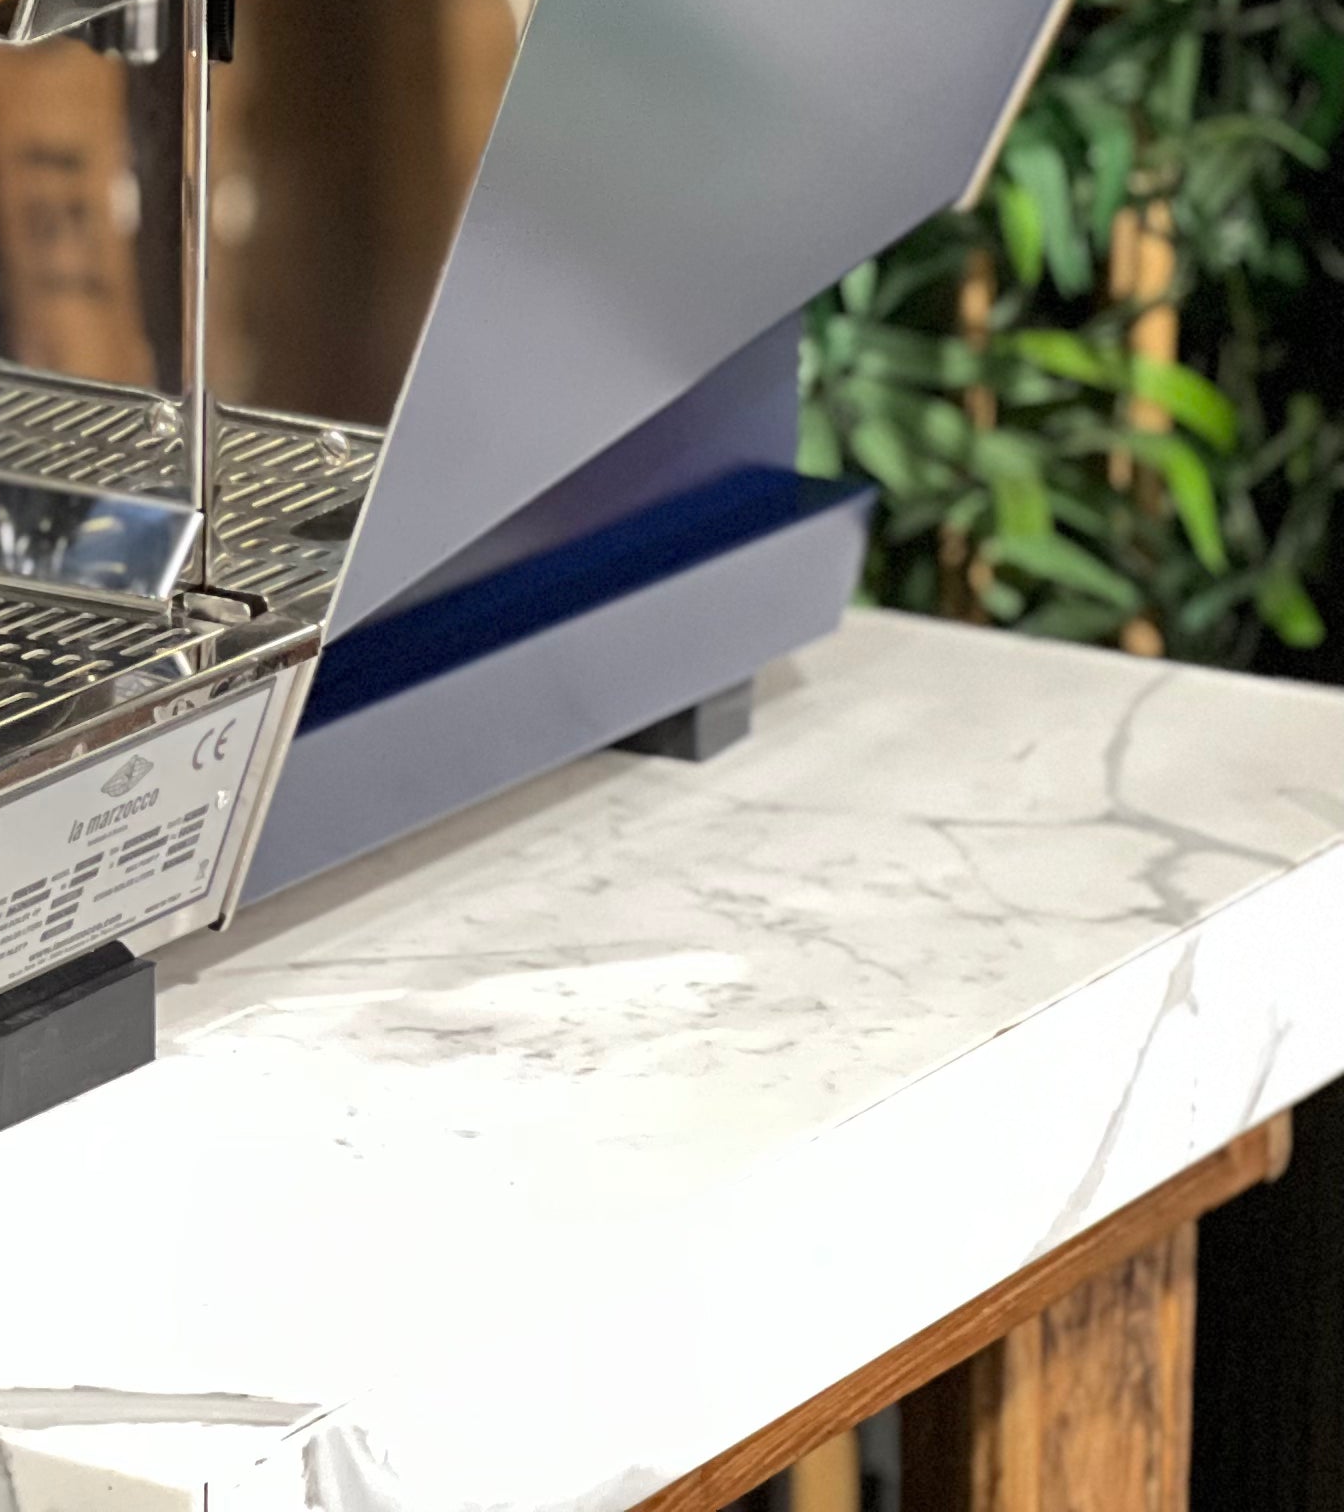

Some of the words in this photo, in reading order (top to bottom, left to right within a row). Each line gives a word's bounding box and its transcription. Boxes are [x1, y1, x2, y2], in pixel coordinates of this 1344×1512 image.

[191, 718, 237, 771] CE
[67, 819, 84, 844] la
[85, 787, 160, 836] marzocco
